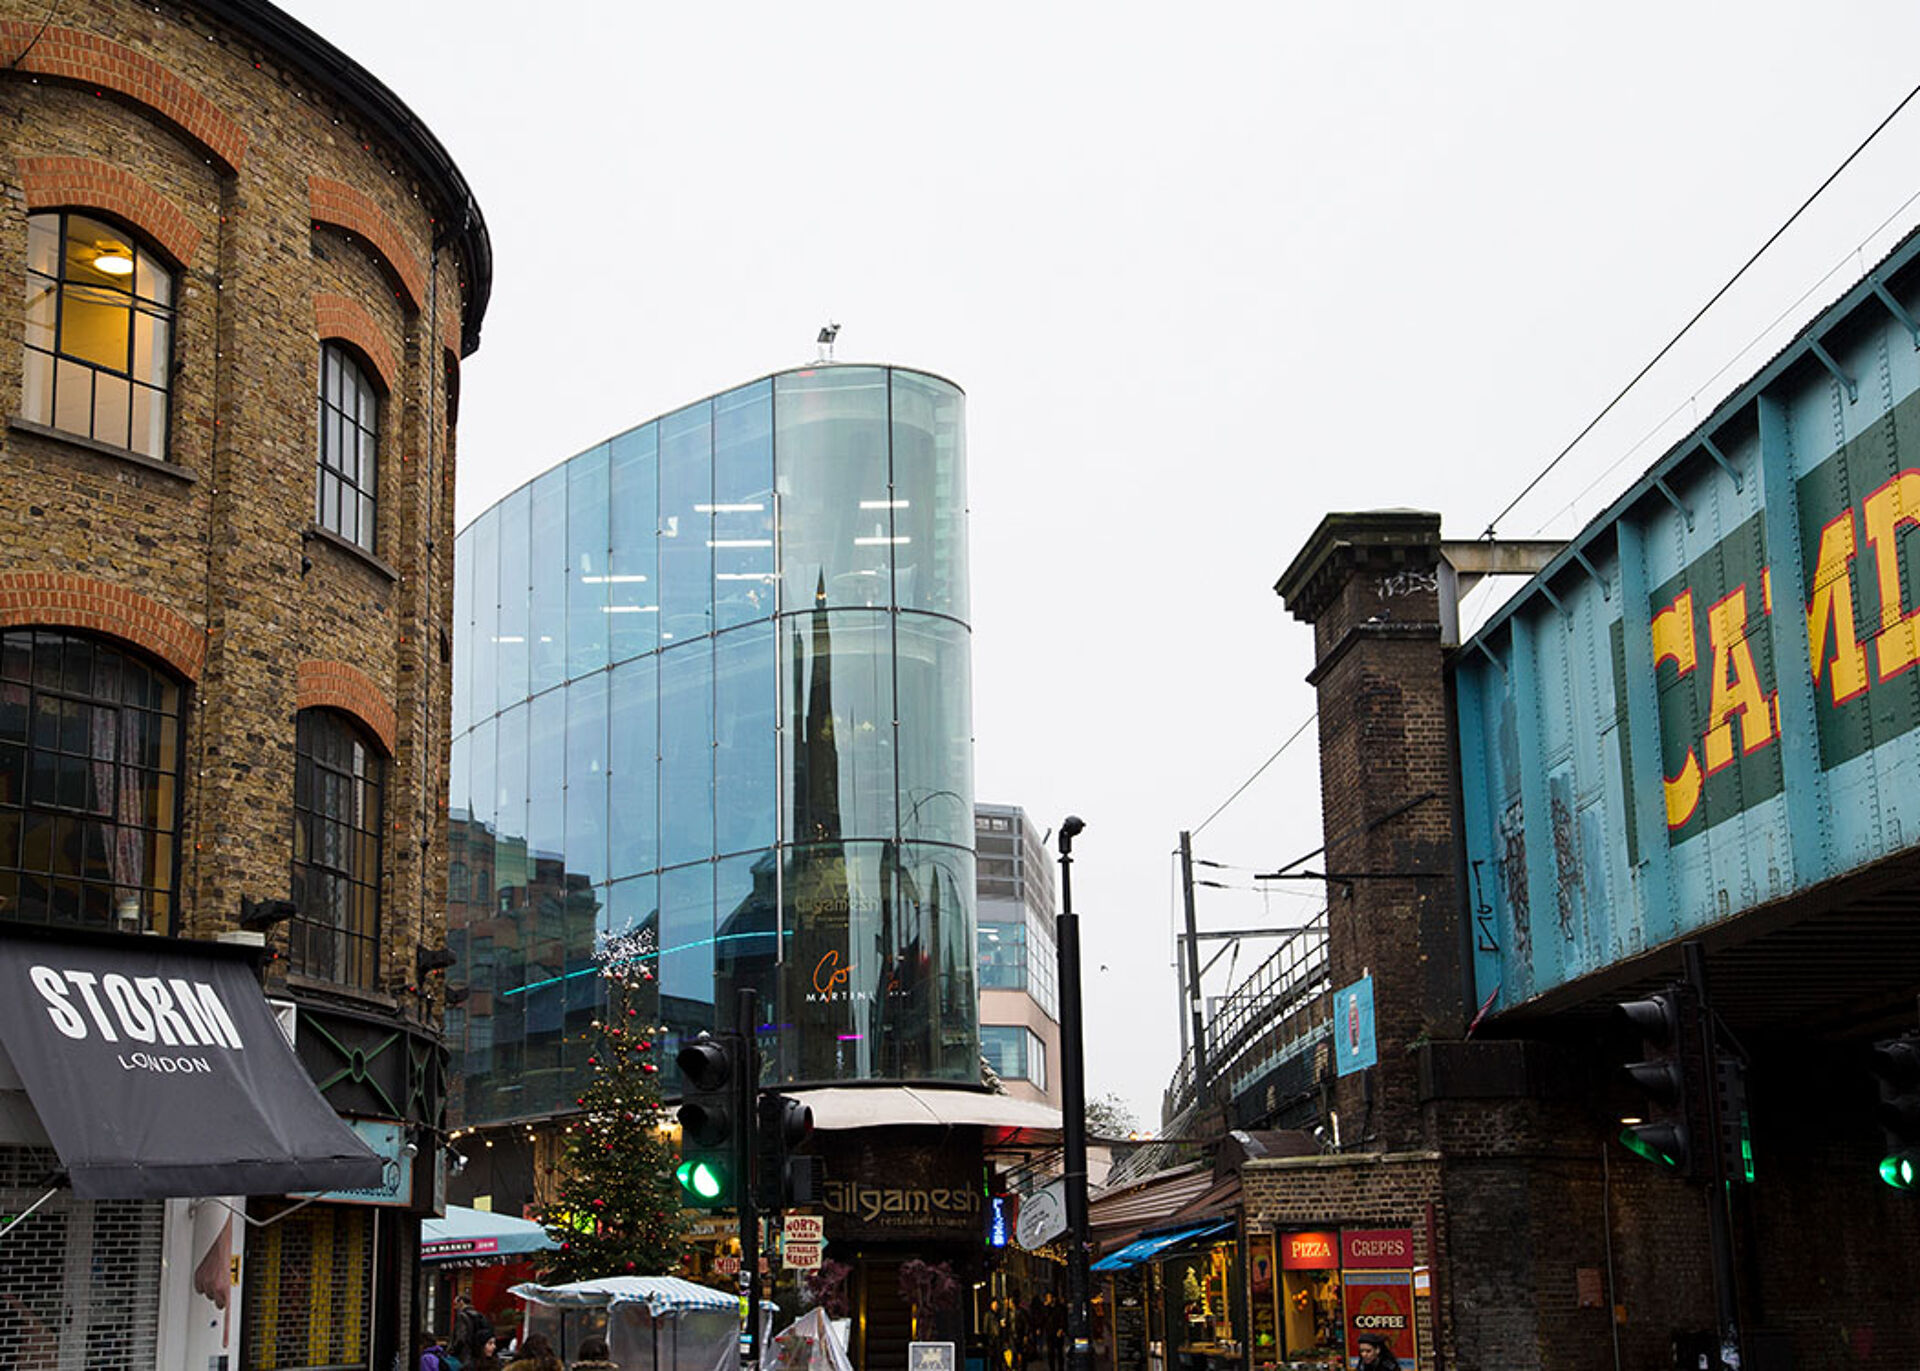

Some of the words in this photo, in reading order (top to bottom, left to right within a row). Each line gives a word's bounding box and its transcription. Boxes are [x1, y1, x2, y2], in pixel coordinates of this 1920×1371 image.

[29, 965, 244, 1050] STORM
[117, 1052, 212, 1073] LONDON
[823, 1180, 981, 1223] Gilgamesh
[785, 1218, 822, 1232] NORTH
[1291, 1241, 1331, 1258] PIZZA
[1351, 1239, 1405, 1257] CREPES
[1355, 1315, 1405, 1328] COFFEE
